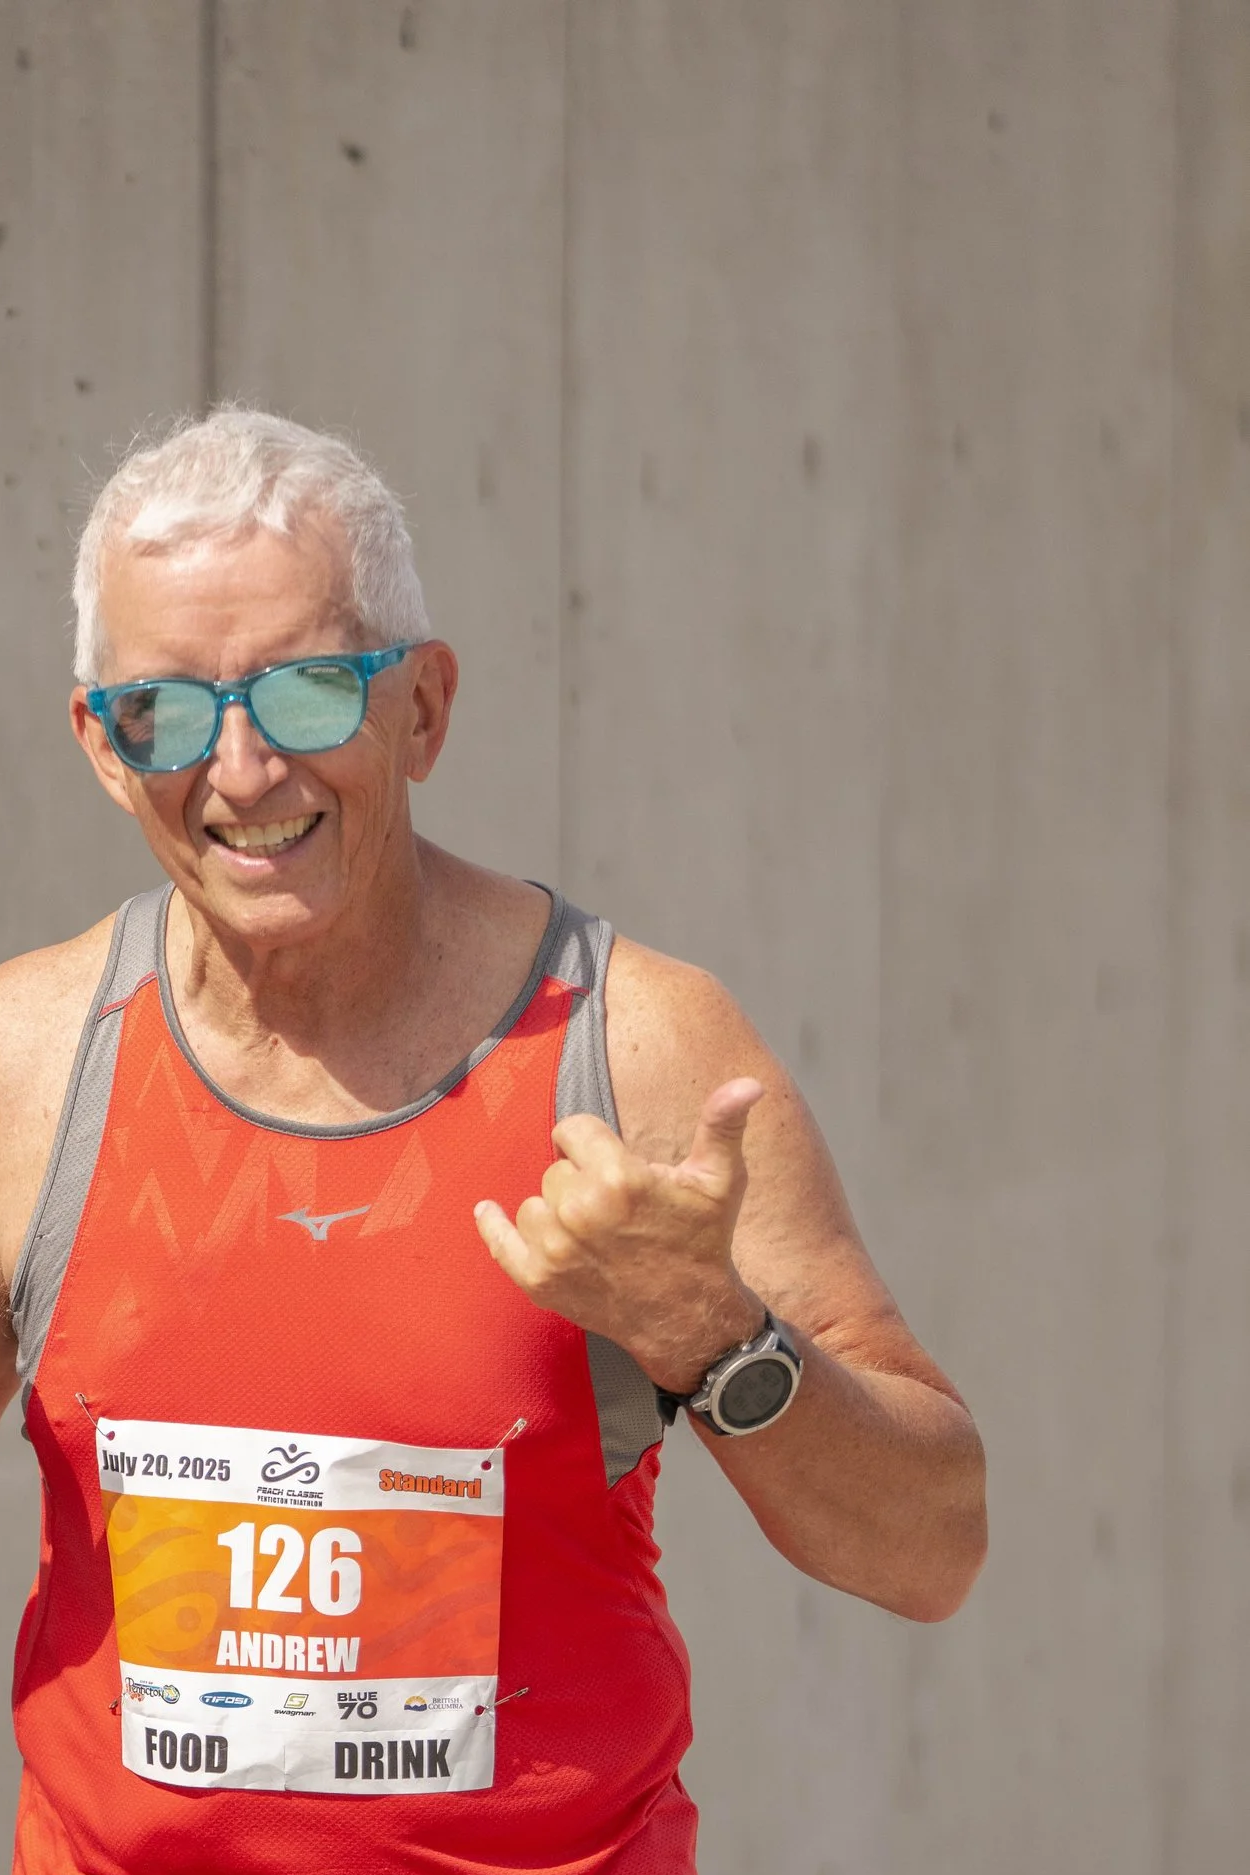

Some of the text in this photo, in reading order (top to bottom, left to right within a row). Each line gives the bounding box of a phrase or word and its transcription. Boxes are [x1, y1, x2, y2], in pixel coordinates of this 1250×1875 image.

[102, 1450, 231, 1482] July 20, 2025
[257, 1486, 324, 1499] PEACH CLASSIC
[379, 1469, 481, 1498] Standard
[257, 1495, 323, 1507] PENTICTON TRIATHLON
[217, 1522, 362, 1616] 126
[216, 1630, 360, 1673] ANDREW
[204, 1695, 248, 1705] TIFOSI
[337, 1692, 378, 1701] BLUE
[274, 1709, 314, 1717] swagman
[337, 1702, 378, 1720] 70
[145, 1727, 451, 1779] FOOD DRINK
